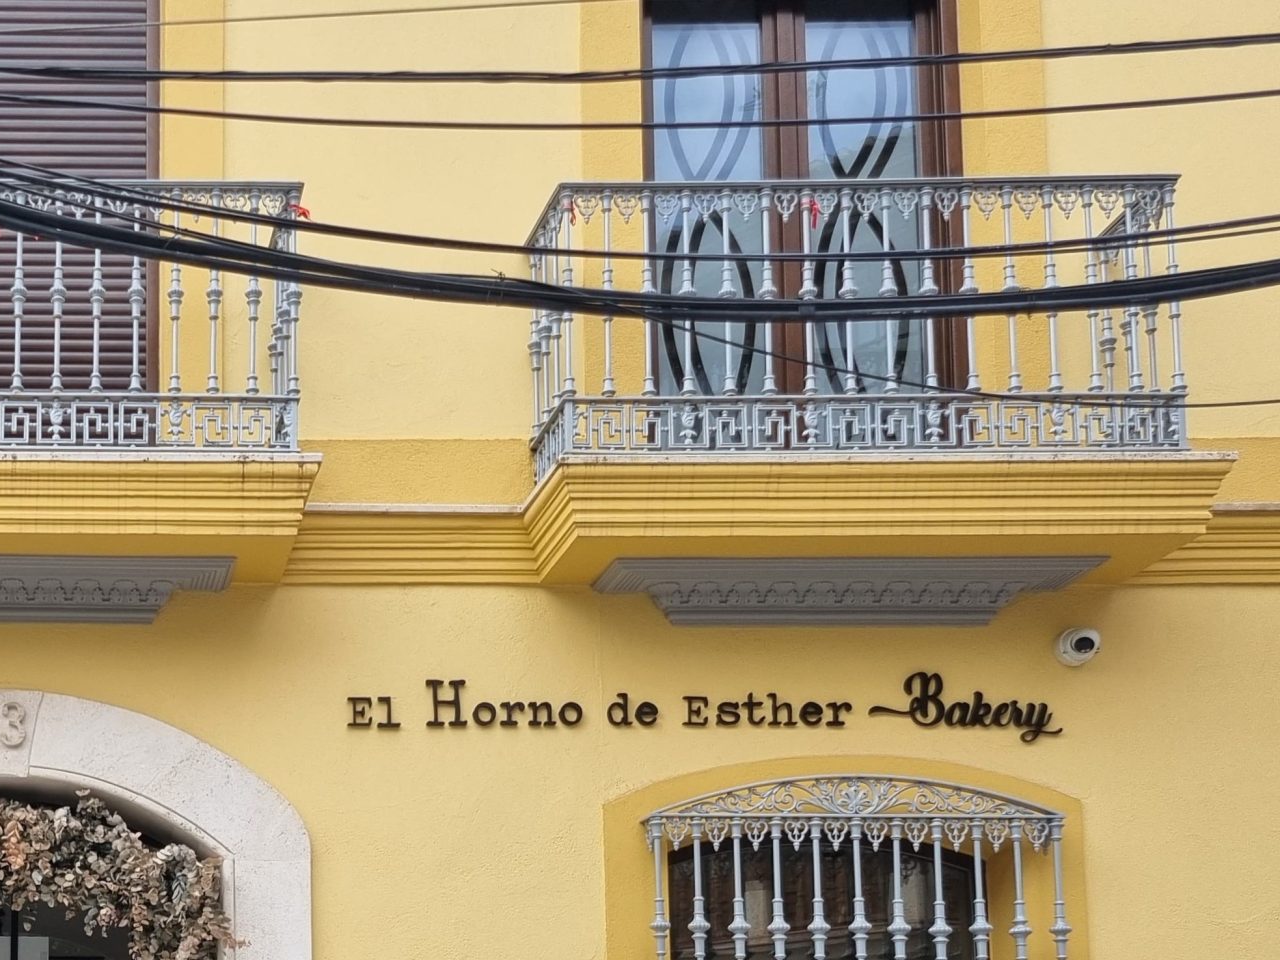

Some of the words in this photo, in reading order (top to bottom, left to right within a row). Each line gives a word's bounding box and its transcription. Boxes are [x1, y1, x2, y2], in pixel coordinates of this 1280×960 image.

[347, 696, 402, 728] El
[425, 679, 583, 728] Horno
[606, 692, 659, 727] de
[681, 692, 853, 728] Esther
[868, 671, 1063, 743] Bakery
